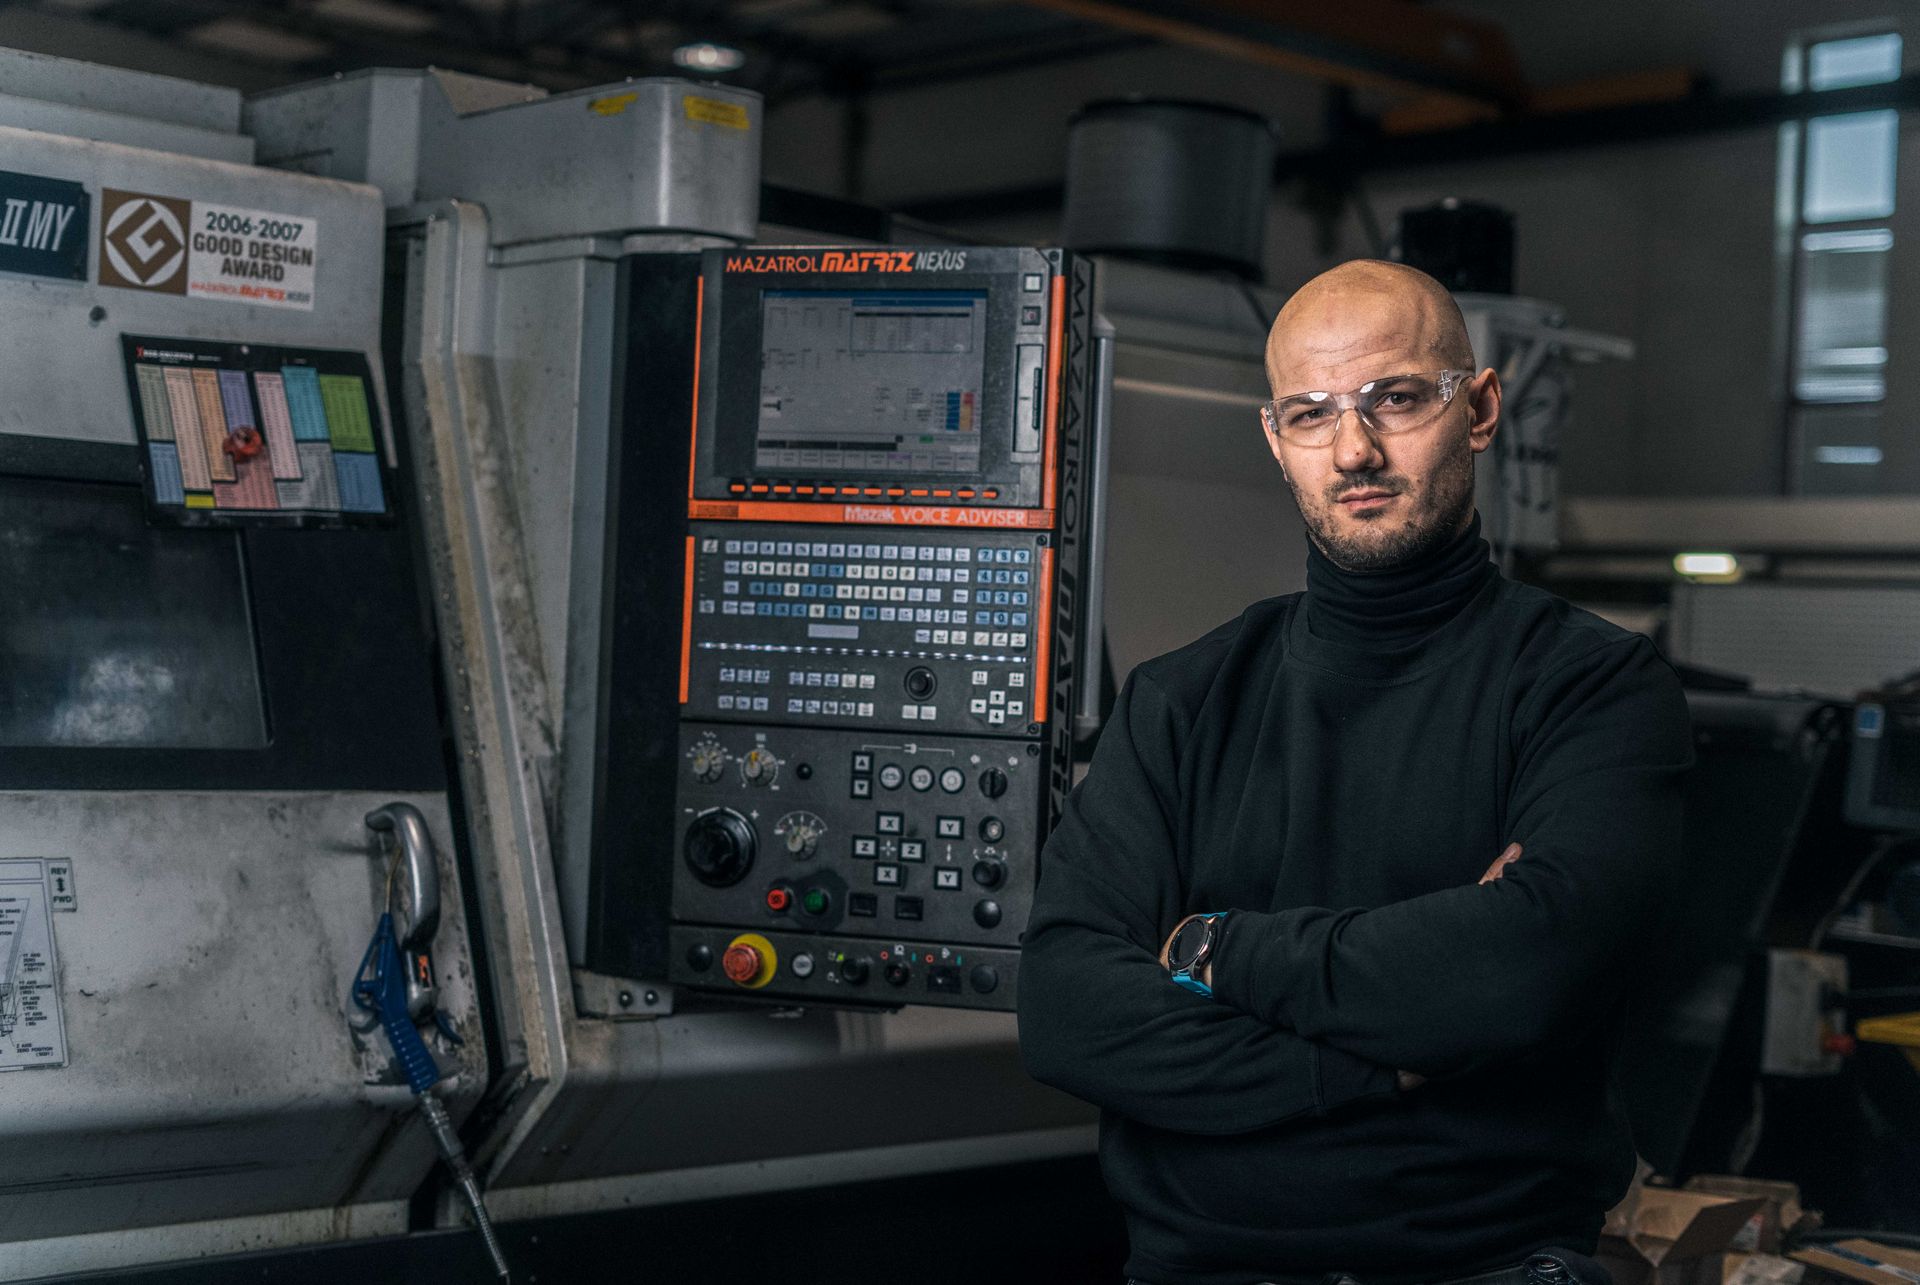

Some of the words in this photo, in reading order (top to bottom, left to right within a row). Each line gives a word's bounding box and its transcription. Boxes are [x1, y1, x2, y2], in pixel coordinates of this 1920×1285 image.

[22, 200, 76, 251] MY
[206, 211, 303, 242] 2006-2007
[193, 232, 243, 257] GOOD
[248, 241, 313, 266] DESIGN
[725, 255, 818, 273] MAZATROL
[820, 252, 915, 273] MATRIX
[915, 249, 967, 272] NEXUS
[221, 258, 284, 282] AWARD
[1062, 262, 1086, 558] MAZATROL
[844, 506, 895, 521] Mazak
[900, 507, 948, 523] VOICE
[956, 509, 1026, 526] ADVISER
[886, 819, 894, 828] X
[946, 823, 954, 832] Y
[861, 843, 869, 852] Z
[907, 846, 916, 855] Z
[50, 867, 67, 875] REV
[884, 870, 891, 878] X
[944, 874, 952, 883] Y
